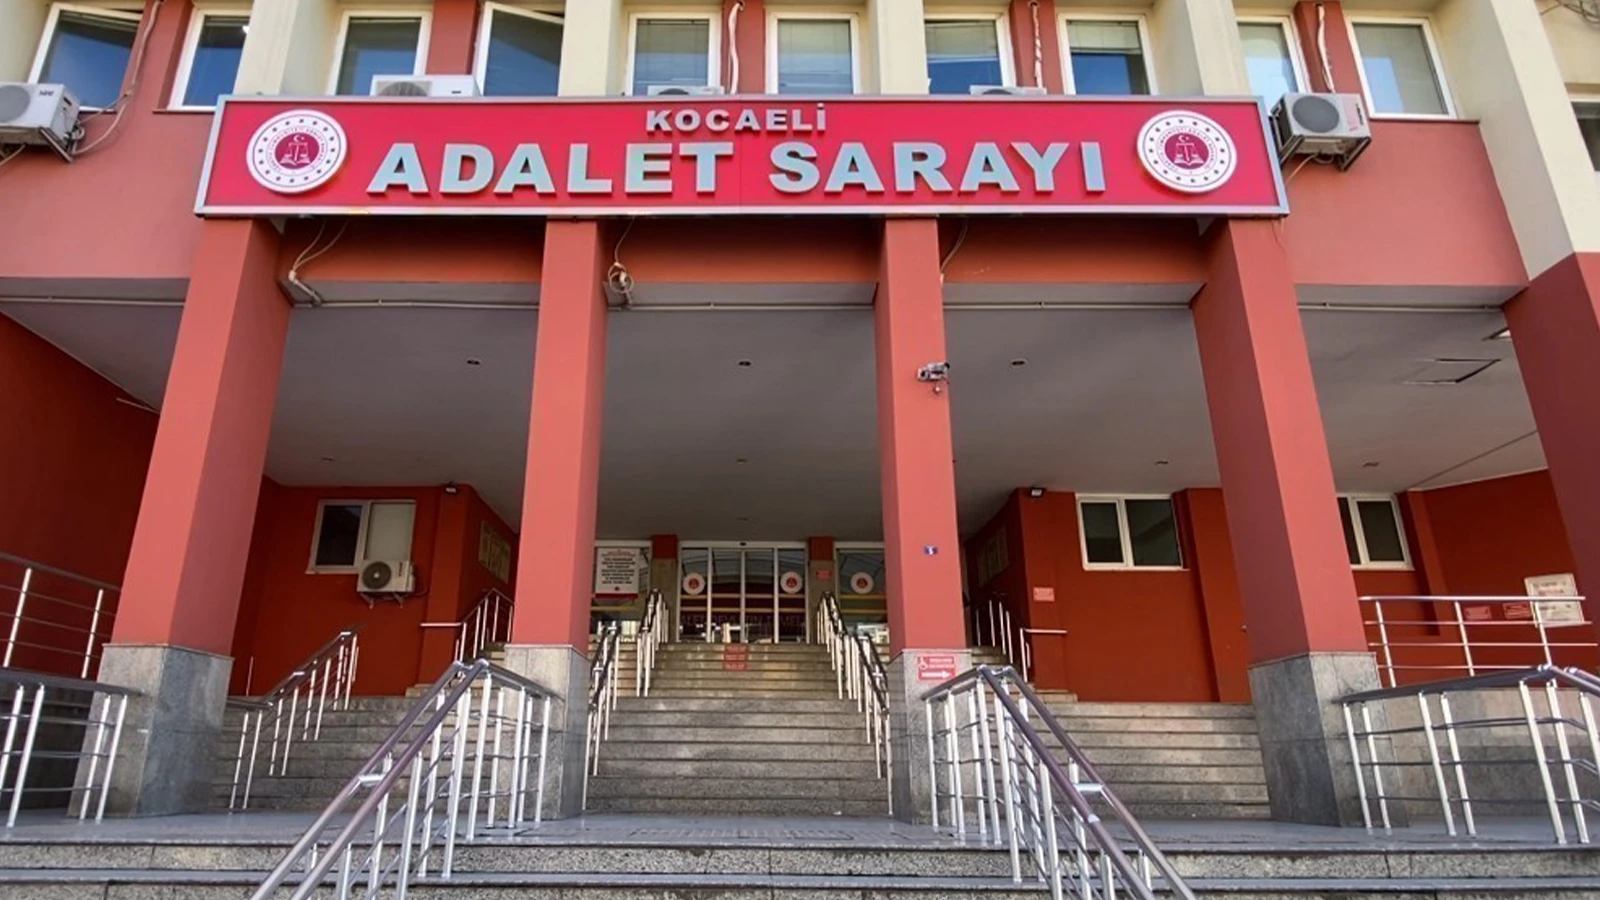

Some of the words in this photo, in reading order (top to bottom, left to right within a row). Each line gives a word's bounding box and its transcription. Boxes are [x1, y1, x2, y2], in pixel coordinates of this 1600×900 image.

[646, 102, 827, 132] KOCAELİ
[366, 142, 735, 194] ADALET
[768, 141, 1107, 193] SARAYI
